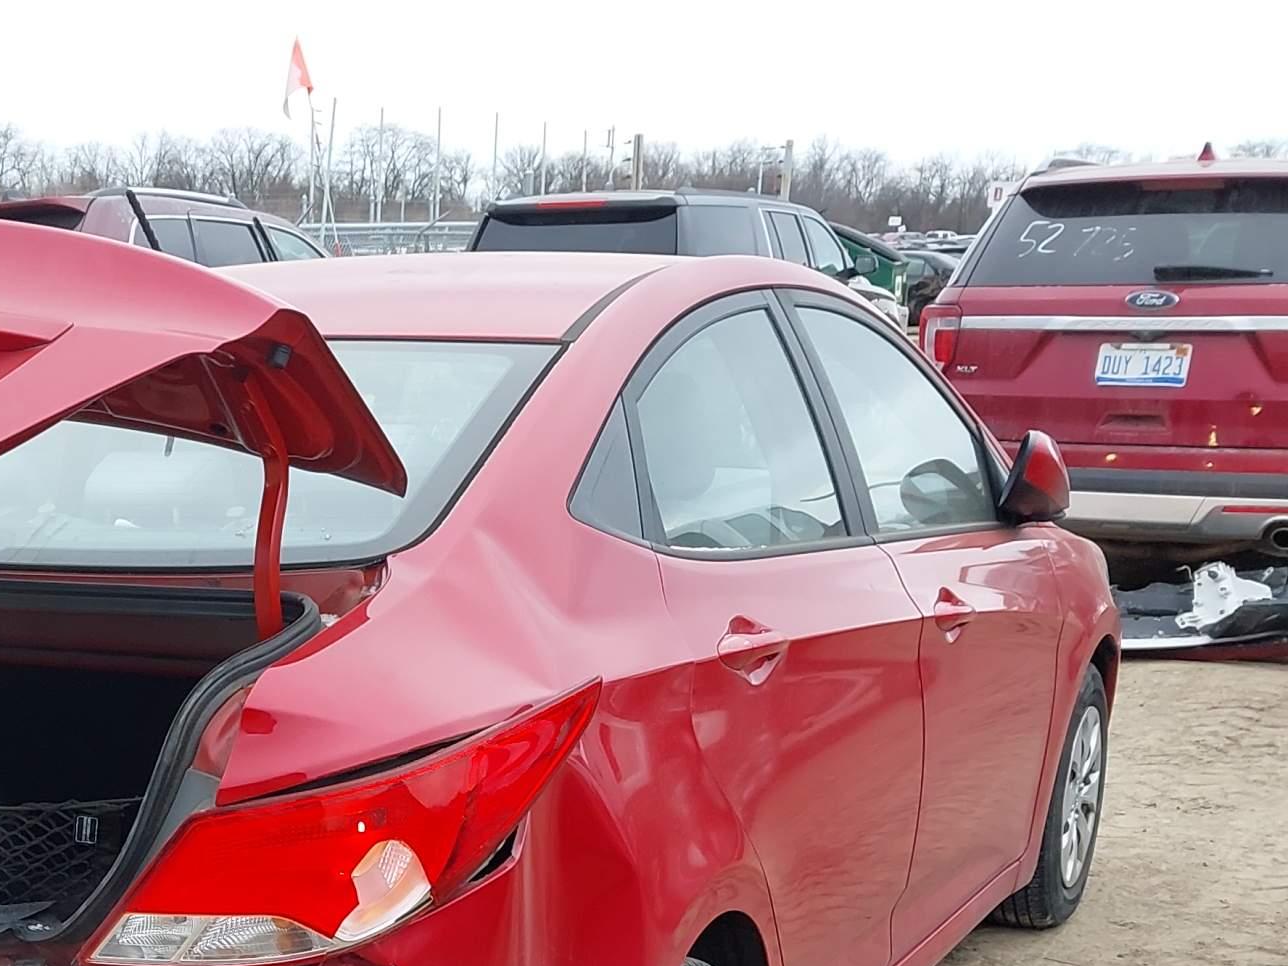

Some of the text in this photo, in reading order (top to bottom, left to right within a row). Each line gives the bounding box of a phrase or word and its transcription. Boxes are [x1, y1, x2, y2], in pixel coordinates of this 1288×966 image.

[1135, 293, 1166, 306] Ford
[1101, 355, 1184, 376] DUY 1423
